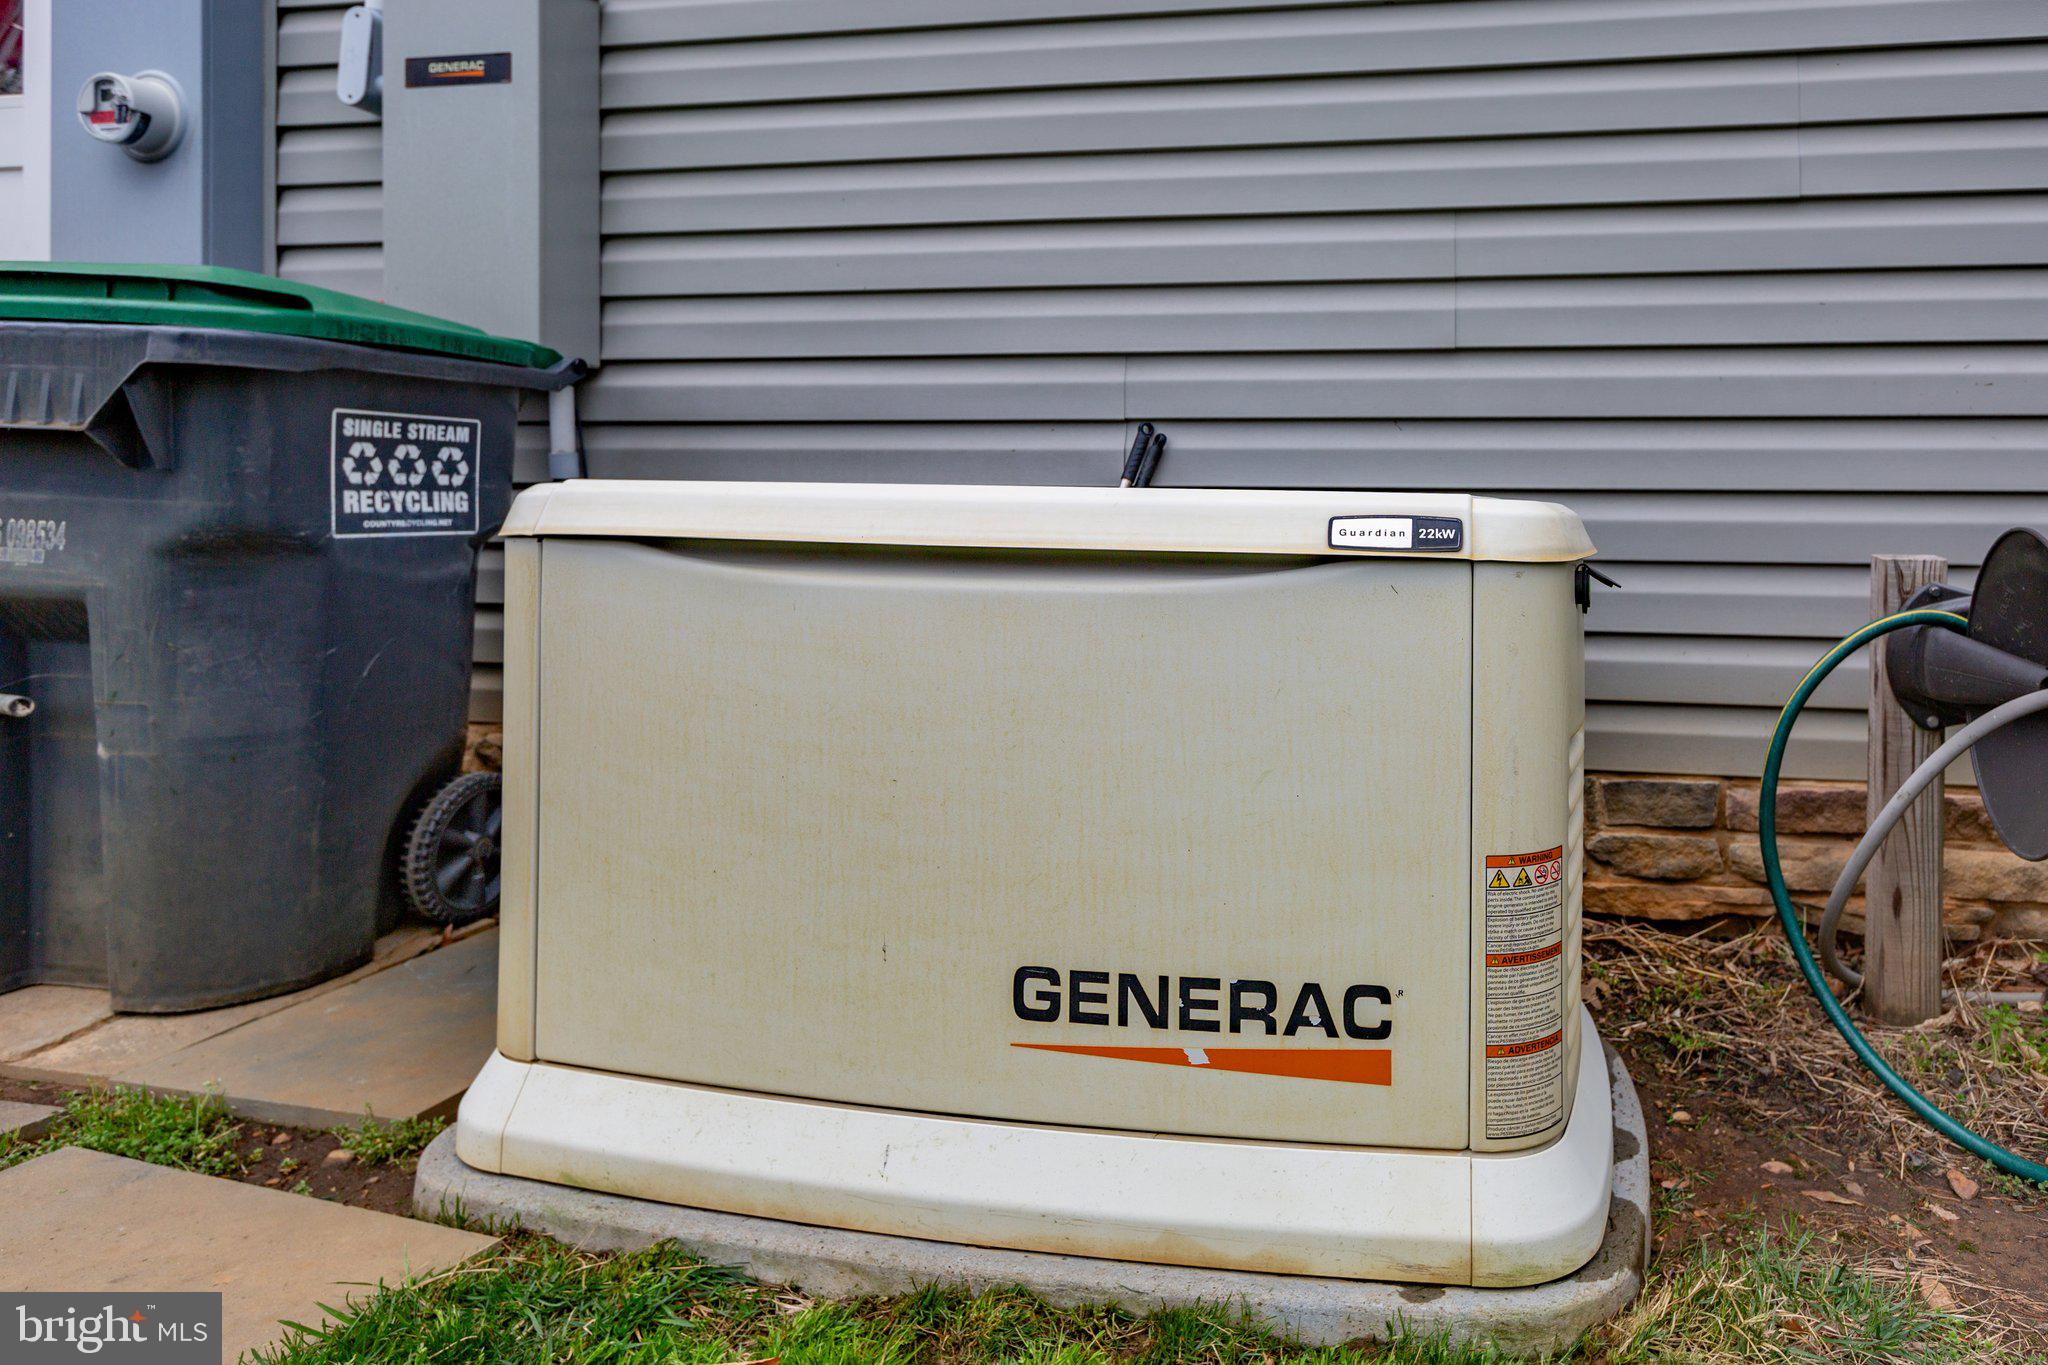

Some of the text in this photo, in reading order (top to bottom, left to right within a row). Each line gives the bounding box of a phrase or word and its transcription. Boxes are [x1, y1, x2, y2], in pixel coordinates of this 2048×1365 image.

[428, 60, 484, 74] GENERAC
[342, 418, 470, 442] SINGLE STREAM
[343, 490, 468, 514] RECYCLING
[1338, 528, 1456, 540] Guardian 22kW
[1518, 852, 1552, 864] WARNING
[1502, 945, 1560, 964] AVERTISSEMENT
[1012, 966, 1392, 1040] GENERAC
[1508, 1034, 1558, 1054] ADVERTENCIA
